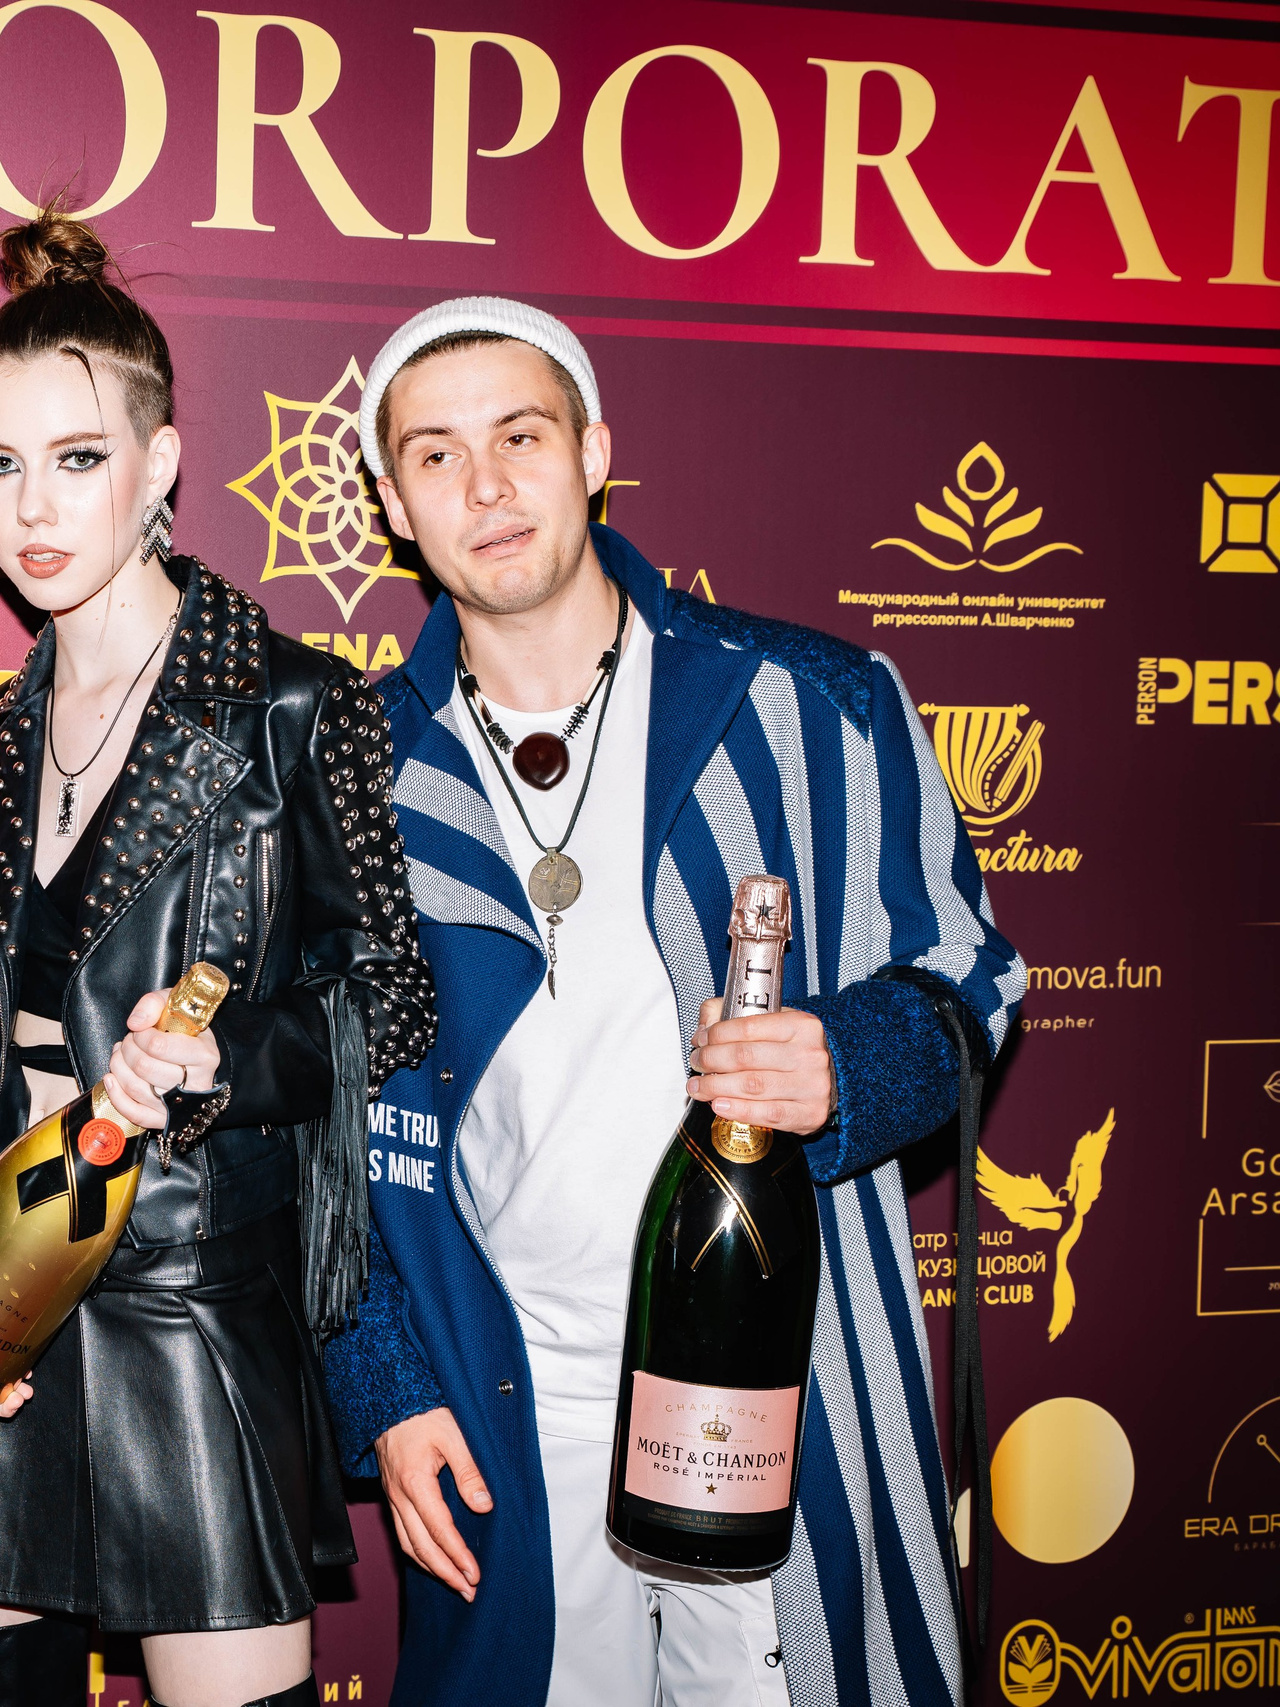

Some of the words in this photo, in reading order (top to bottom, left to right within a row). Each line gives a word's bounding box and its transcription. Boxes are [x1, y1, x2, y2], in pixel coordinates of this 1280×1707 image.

[838, 589, 960, 608] Международный
[962, 592, 1015, 607] онлайн
[1017, 597, 1106, 611] университет
[873, 613, 978, 628] регрессологии
[1136, 657, 1158, 725] PERSON
[1157, 657, 1280, 725] PER
[967, 829, 1083, 873] actura
[400, 1109, 441, 1149] TRU
[388, 1151, 436, 1194] MINE
[913, 1232, 948, 1253] атр
[918, 1251, 1047, 1279] КУЗЦОВОЙ
[983, 1284, 1034, 1305] CLUB
[665, 1403, 769, 1424] CHAMPAGNE
[636, 1436, 683, 1462] MOËT
[687, 1451, 698, 1465] &
[702, 1450, 787, 1470] CHANDON
[653, 1462, 690, 1477] ROSÉ
[697, 1470, 767, 1483] IMPÉRIAL
[1184, 1516, 1239, 1538] ERA
